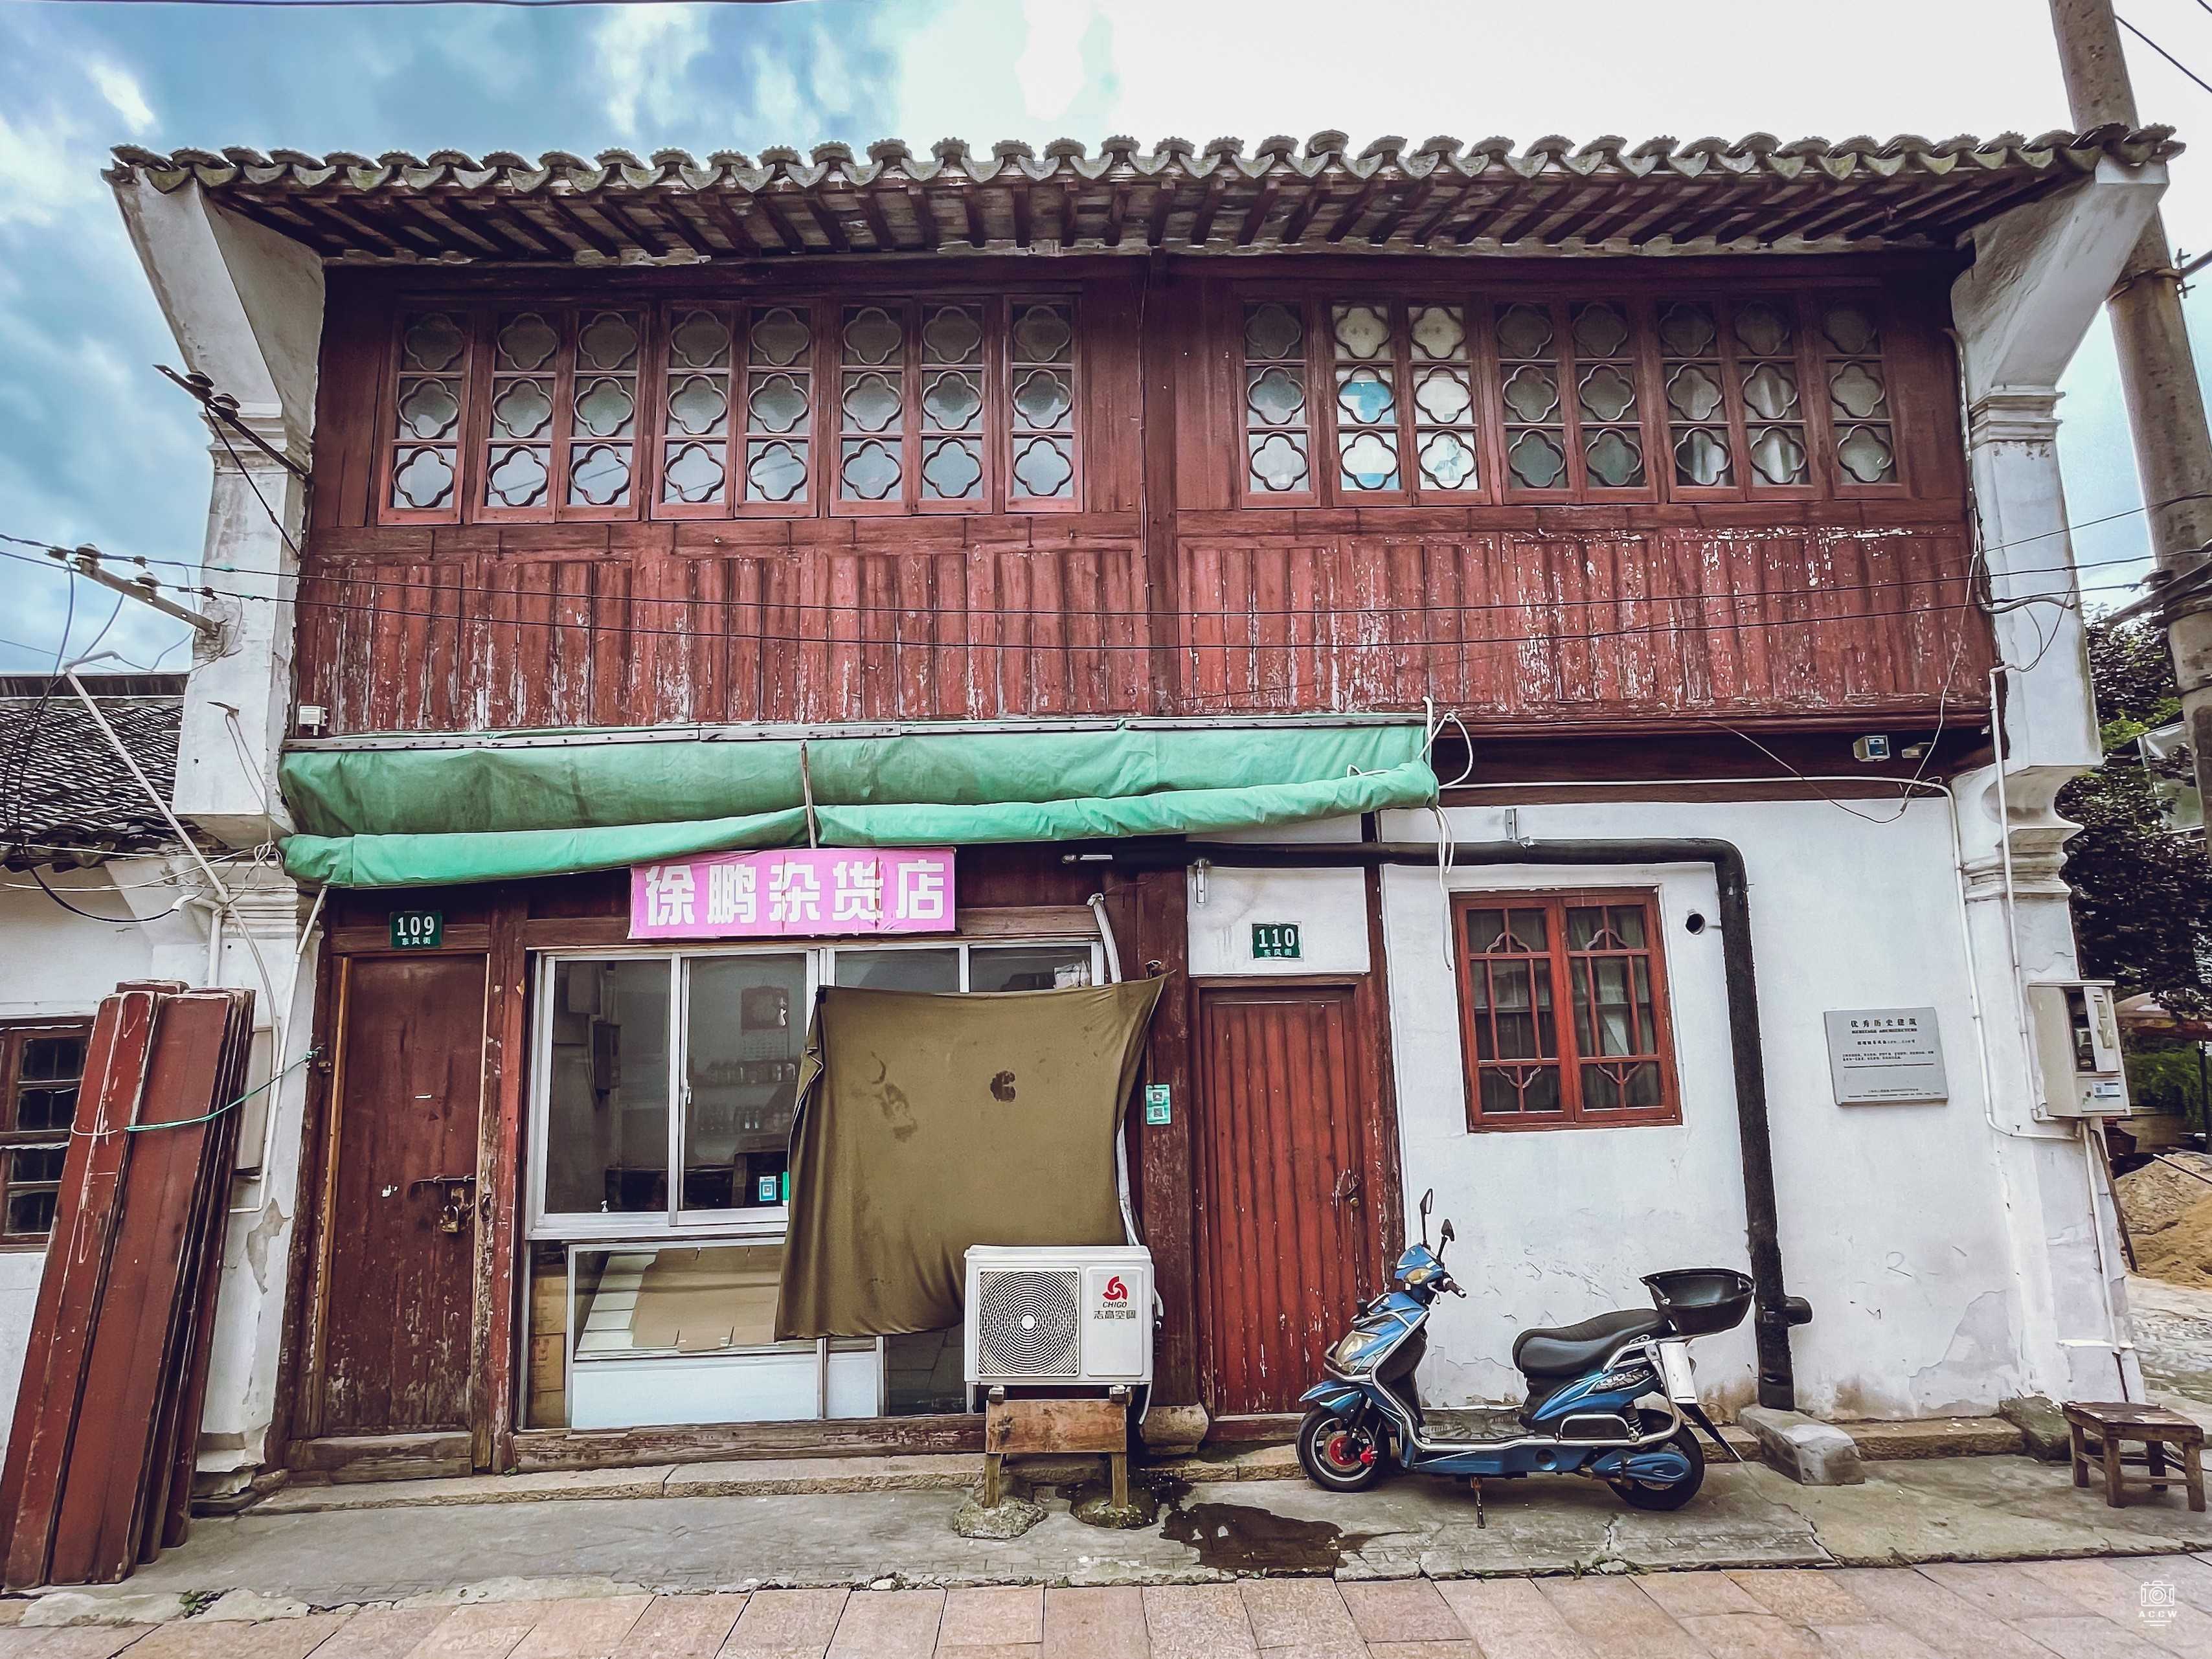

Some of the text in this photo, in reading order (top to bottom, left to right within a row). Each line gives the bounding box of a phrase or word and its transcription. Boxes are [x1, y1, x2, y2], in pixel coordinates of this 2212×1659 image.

[645, 859, 945, 926] 徐鹏杂货店
[397, 916, 435, 936] 109
[1259, 928, 1294, 947] 110
[1851, 1018, 1917, 1028] 优秀历史建筑
